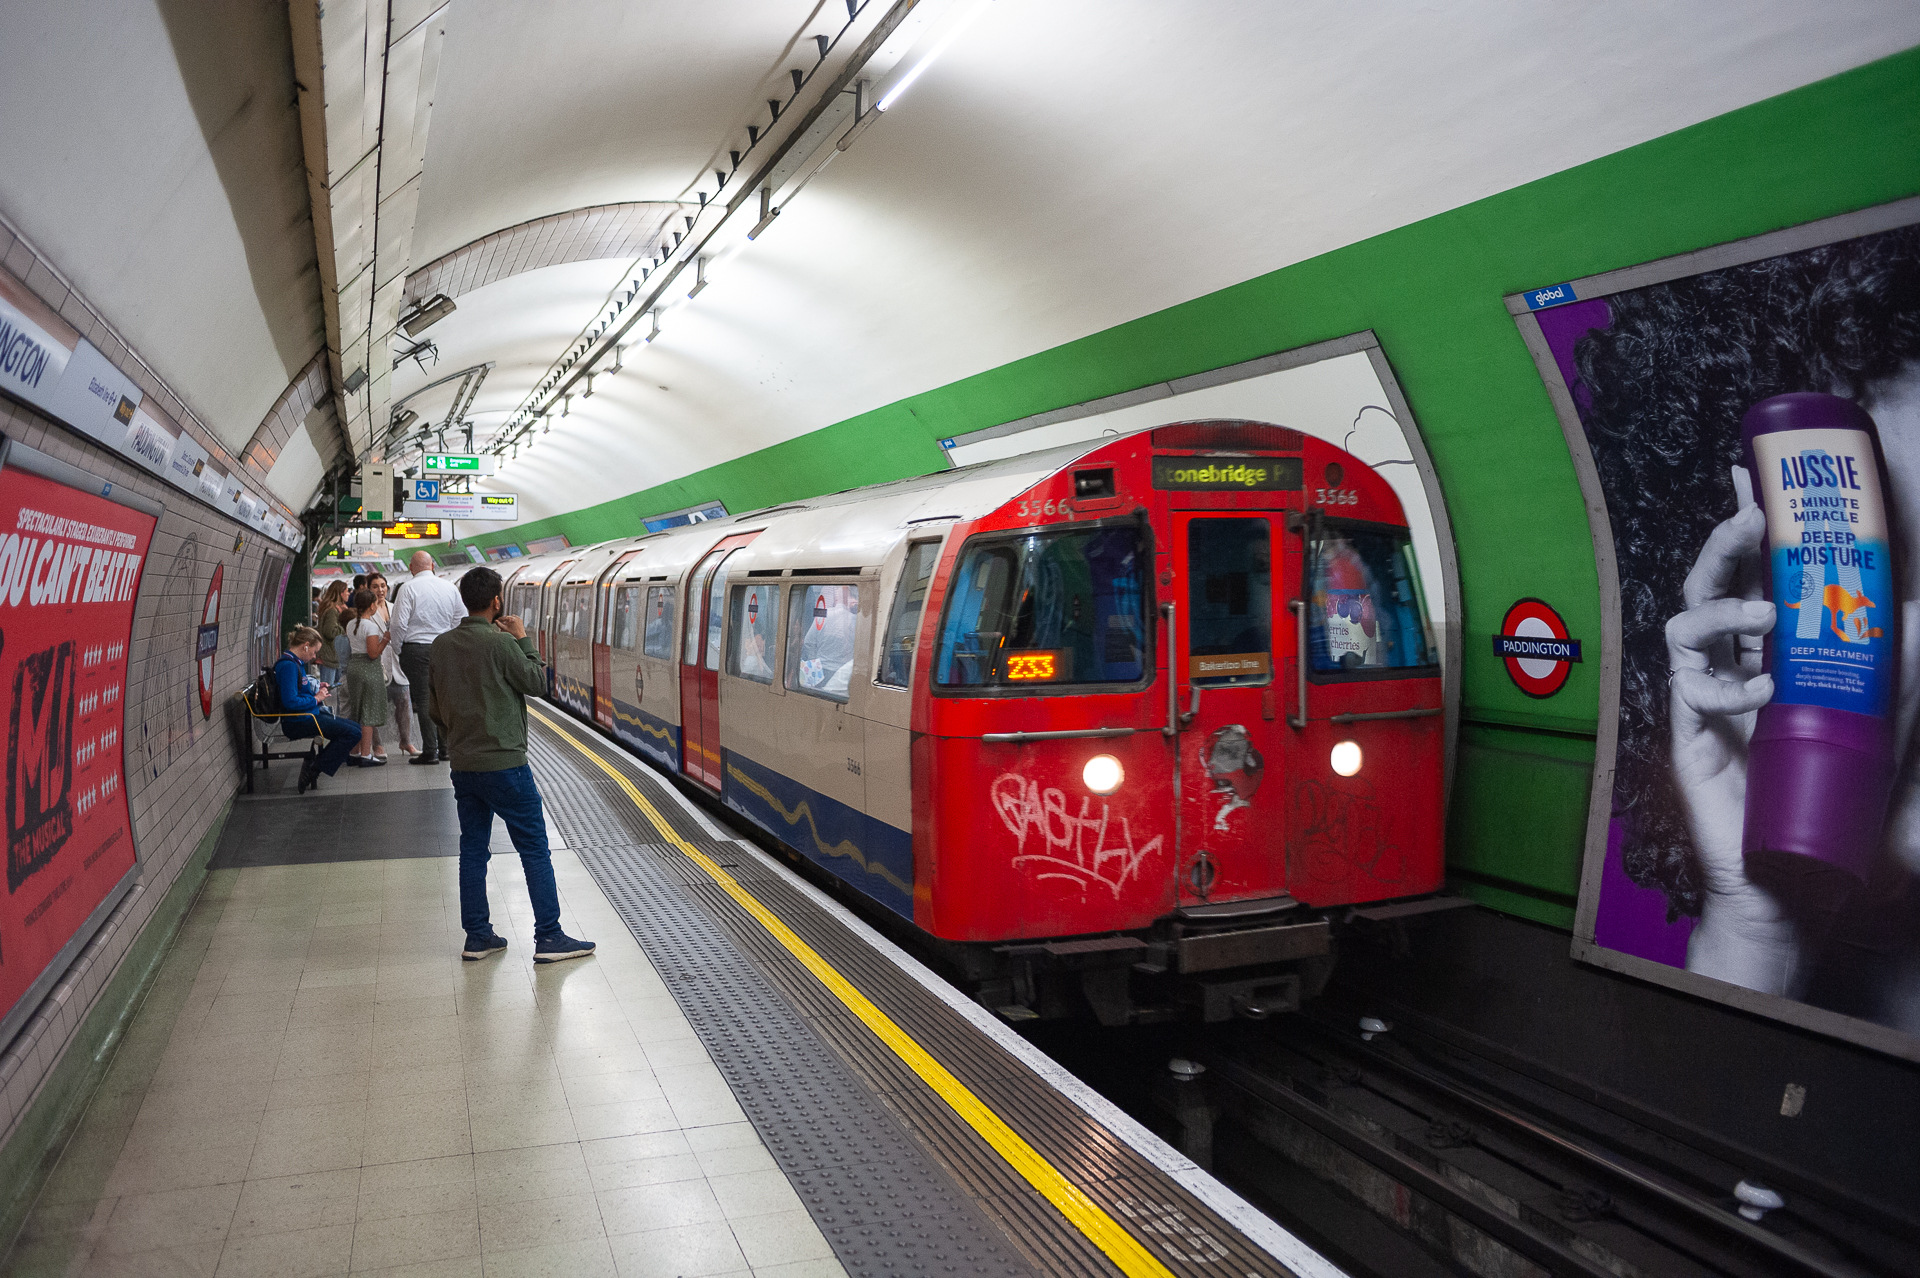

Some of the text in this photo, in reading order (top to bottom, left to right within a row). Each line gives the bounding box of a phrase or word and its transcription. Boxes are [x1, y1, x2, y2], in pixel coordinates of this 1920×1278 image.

[1535, 286, 1564, 306] global
[0, 316, 51, 388] NGTON
[1781, 455, 1861, 491] AUSSIE
[1315, 488, 1358, 505] 3566
[1789, 497, 1860, 510] 3 MINUTE
[1017, 499, 1070, 517] 3566
[1794, 511, 1859, 523] MIRACLE
[1801, 531, 1856, 545] DEEEP
[1787, 547, 1877, 571] MOISTURE
[29, 539, 93, 607] CAN'T
[82, 548, 127, 603] BEAT
[122, 554, 142, 602] IT!
[1331, 637, 1361, 651] cherries
[1503, 640, 1570, 656] PADDINGTON
[1790, 647, 1875, 662] DEEP TREATMENT
[1007, 655, 1054, 679] 233
[1199, 659, 1260, 671] Bakerloo line
[14, 832, 32, 873] THE
[32, 810, 66, 858] MUSICAL
